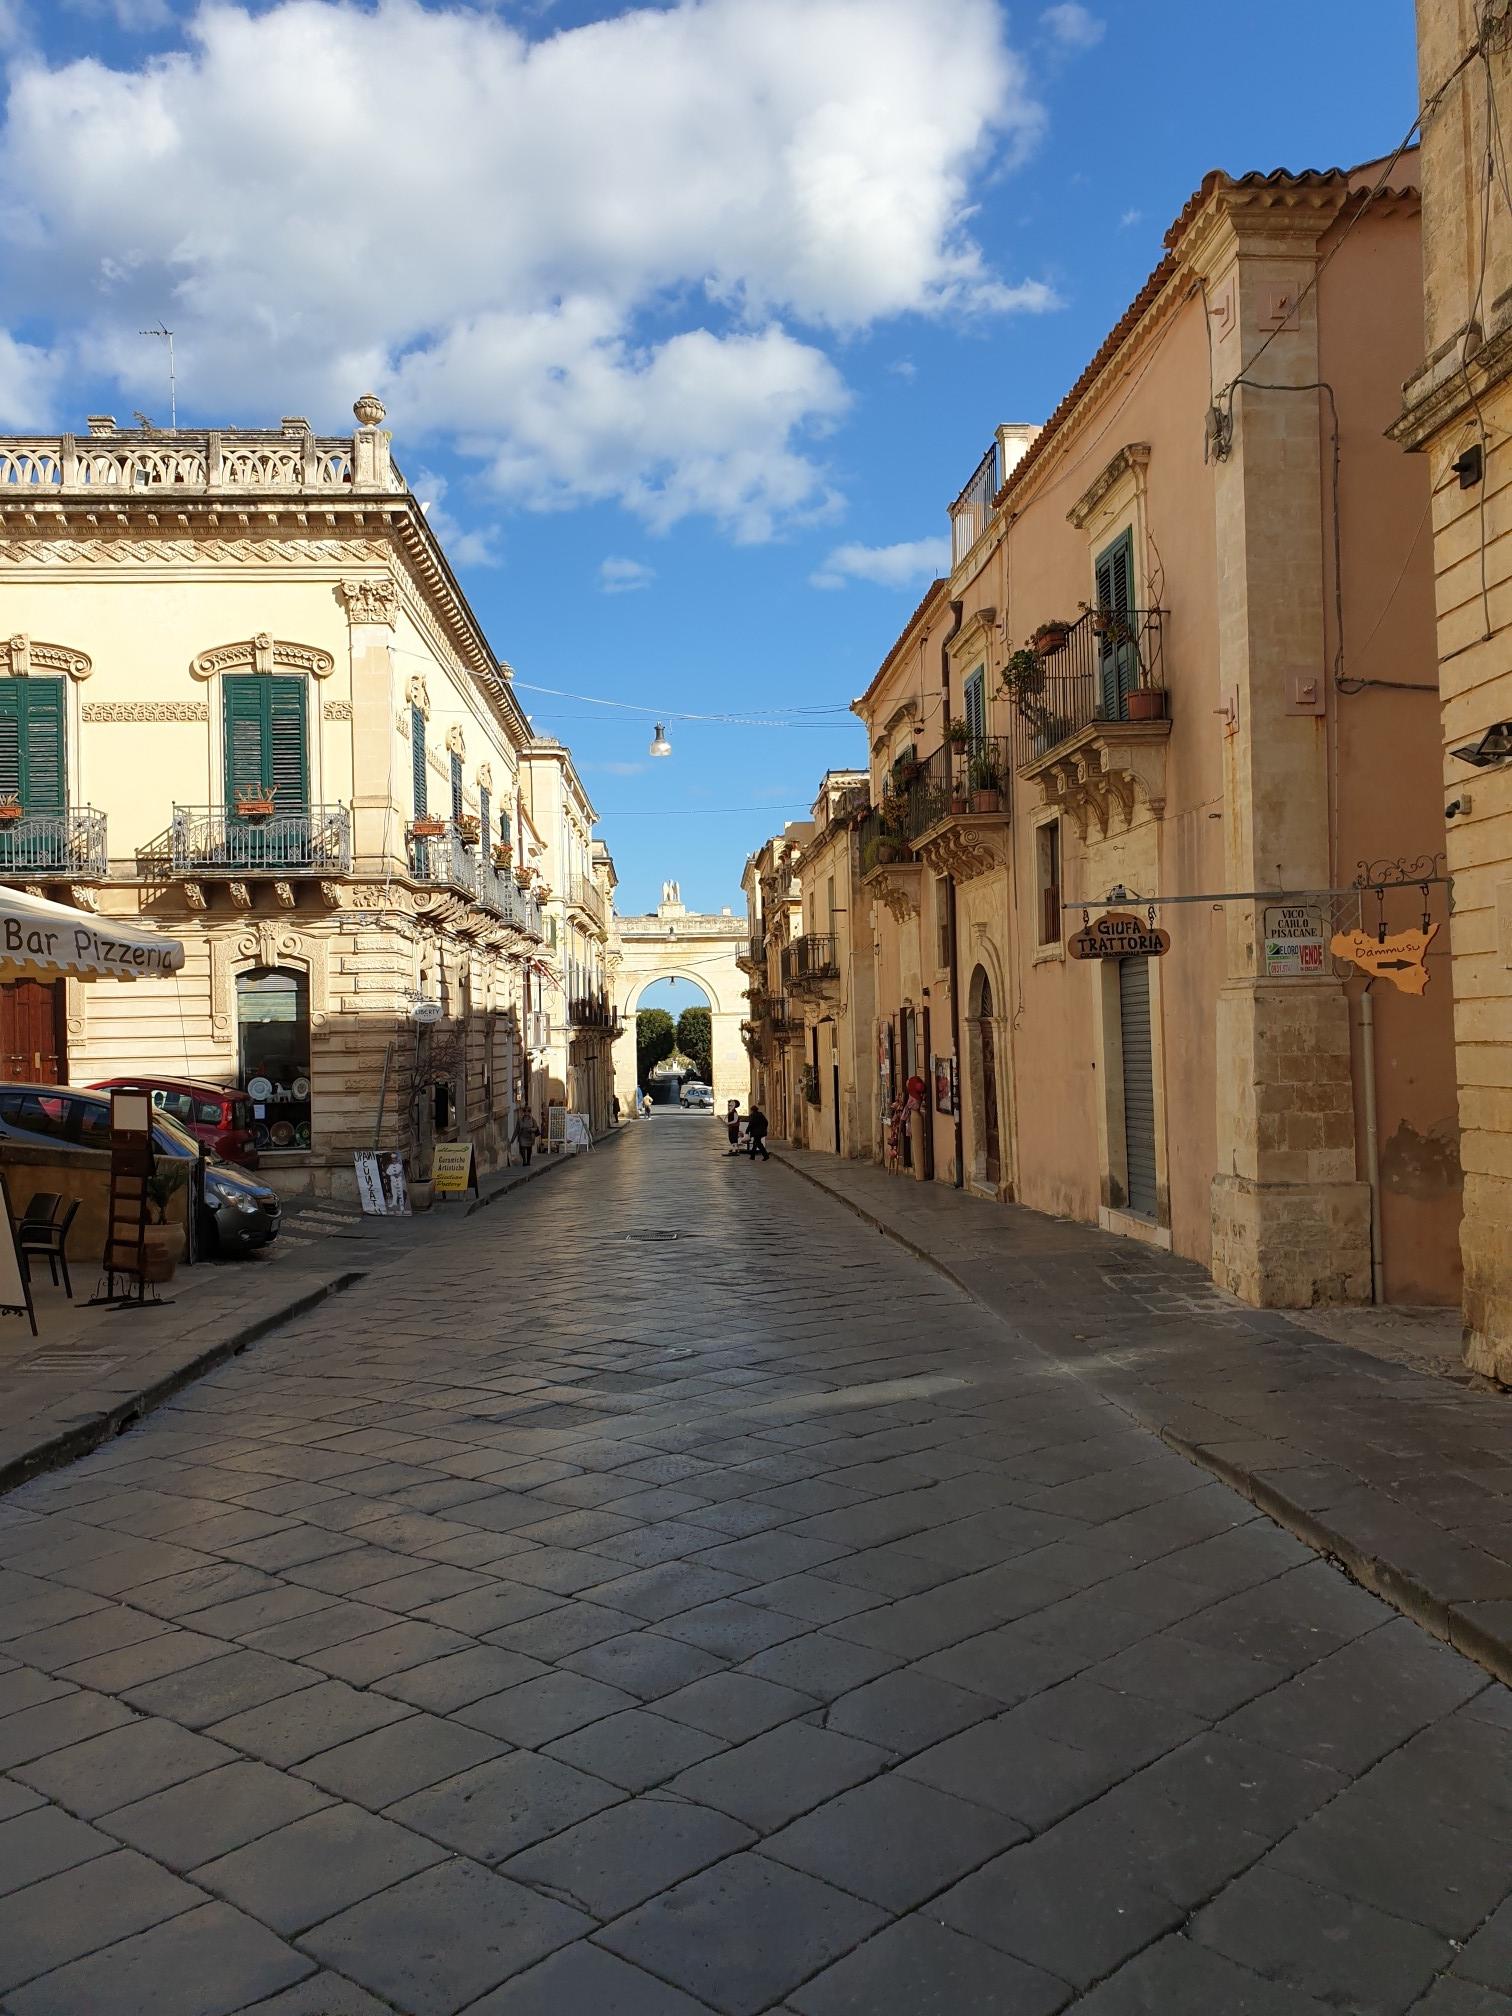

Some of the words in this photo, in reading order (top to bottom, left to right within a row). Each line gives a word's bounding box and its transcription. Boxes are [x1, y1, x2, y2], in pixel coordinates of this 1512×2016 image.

[1281, 909, 1304, 919] VICO
[1277, 919, 1309, 928] CARLO
[1271, 928, 1318, 938] PISACANE
[4, 918, 58, 956] Bar
[74, 929, 172, 969] Pizzeria
[1077, 935, 1164, 952] TRATTORIA
[1299, 944, 1323, 966] VENDE
